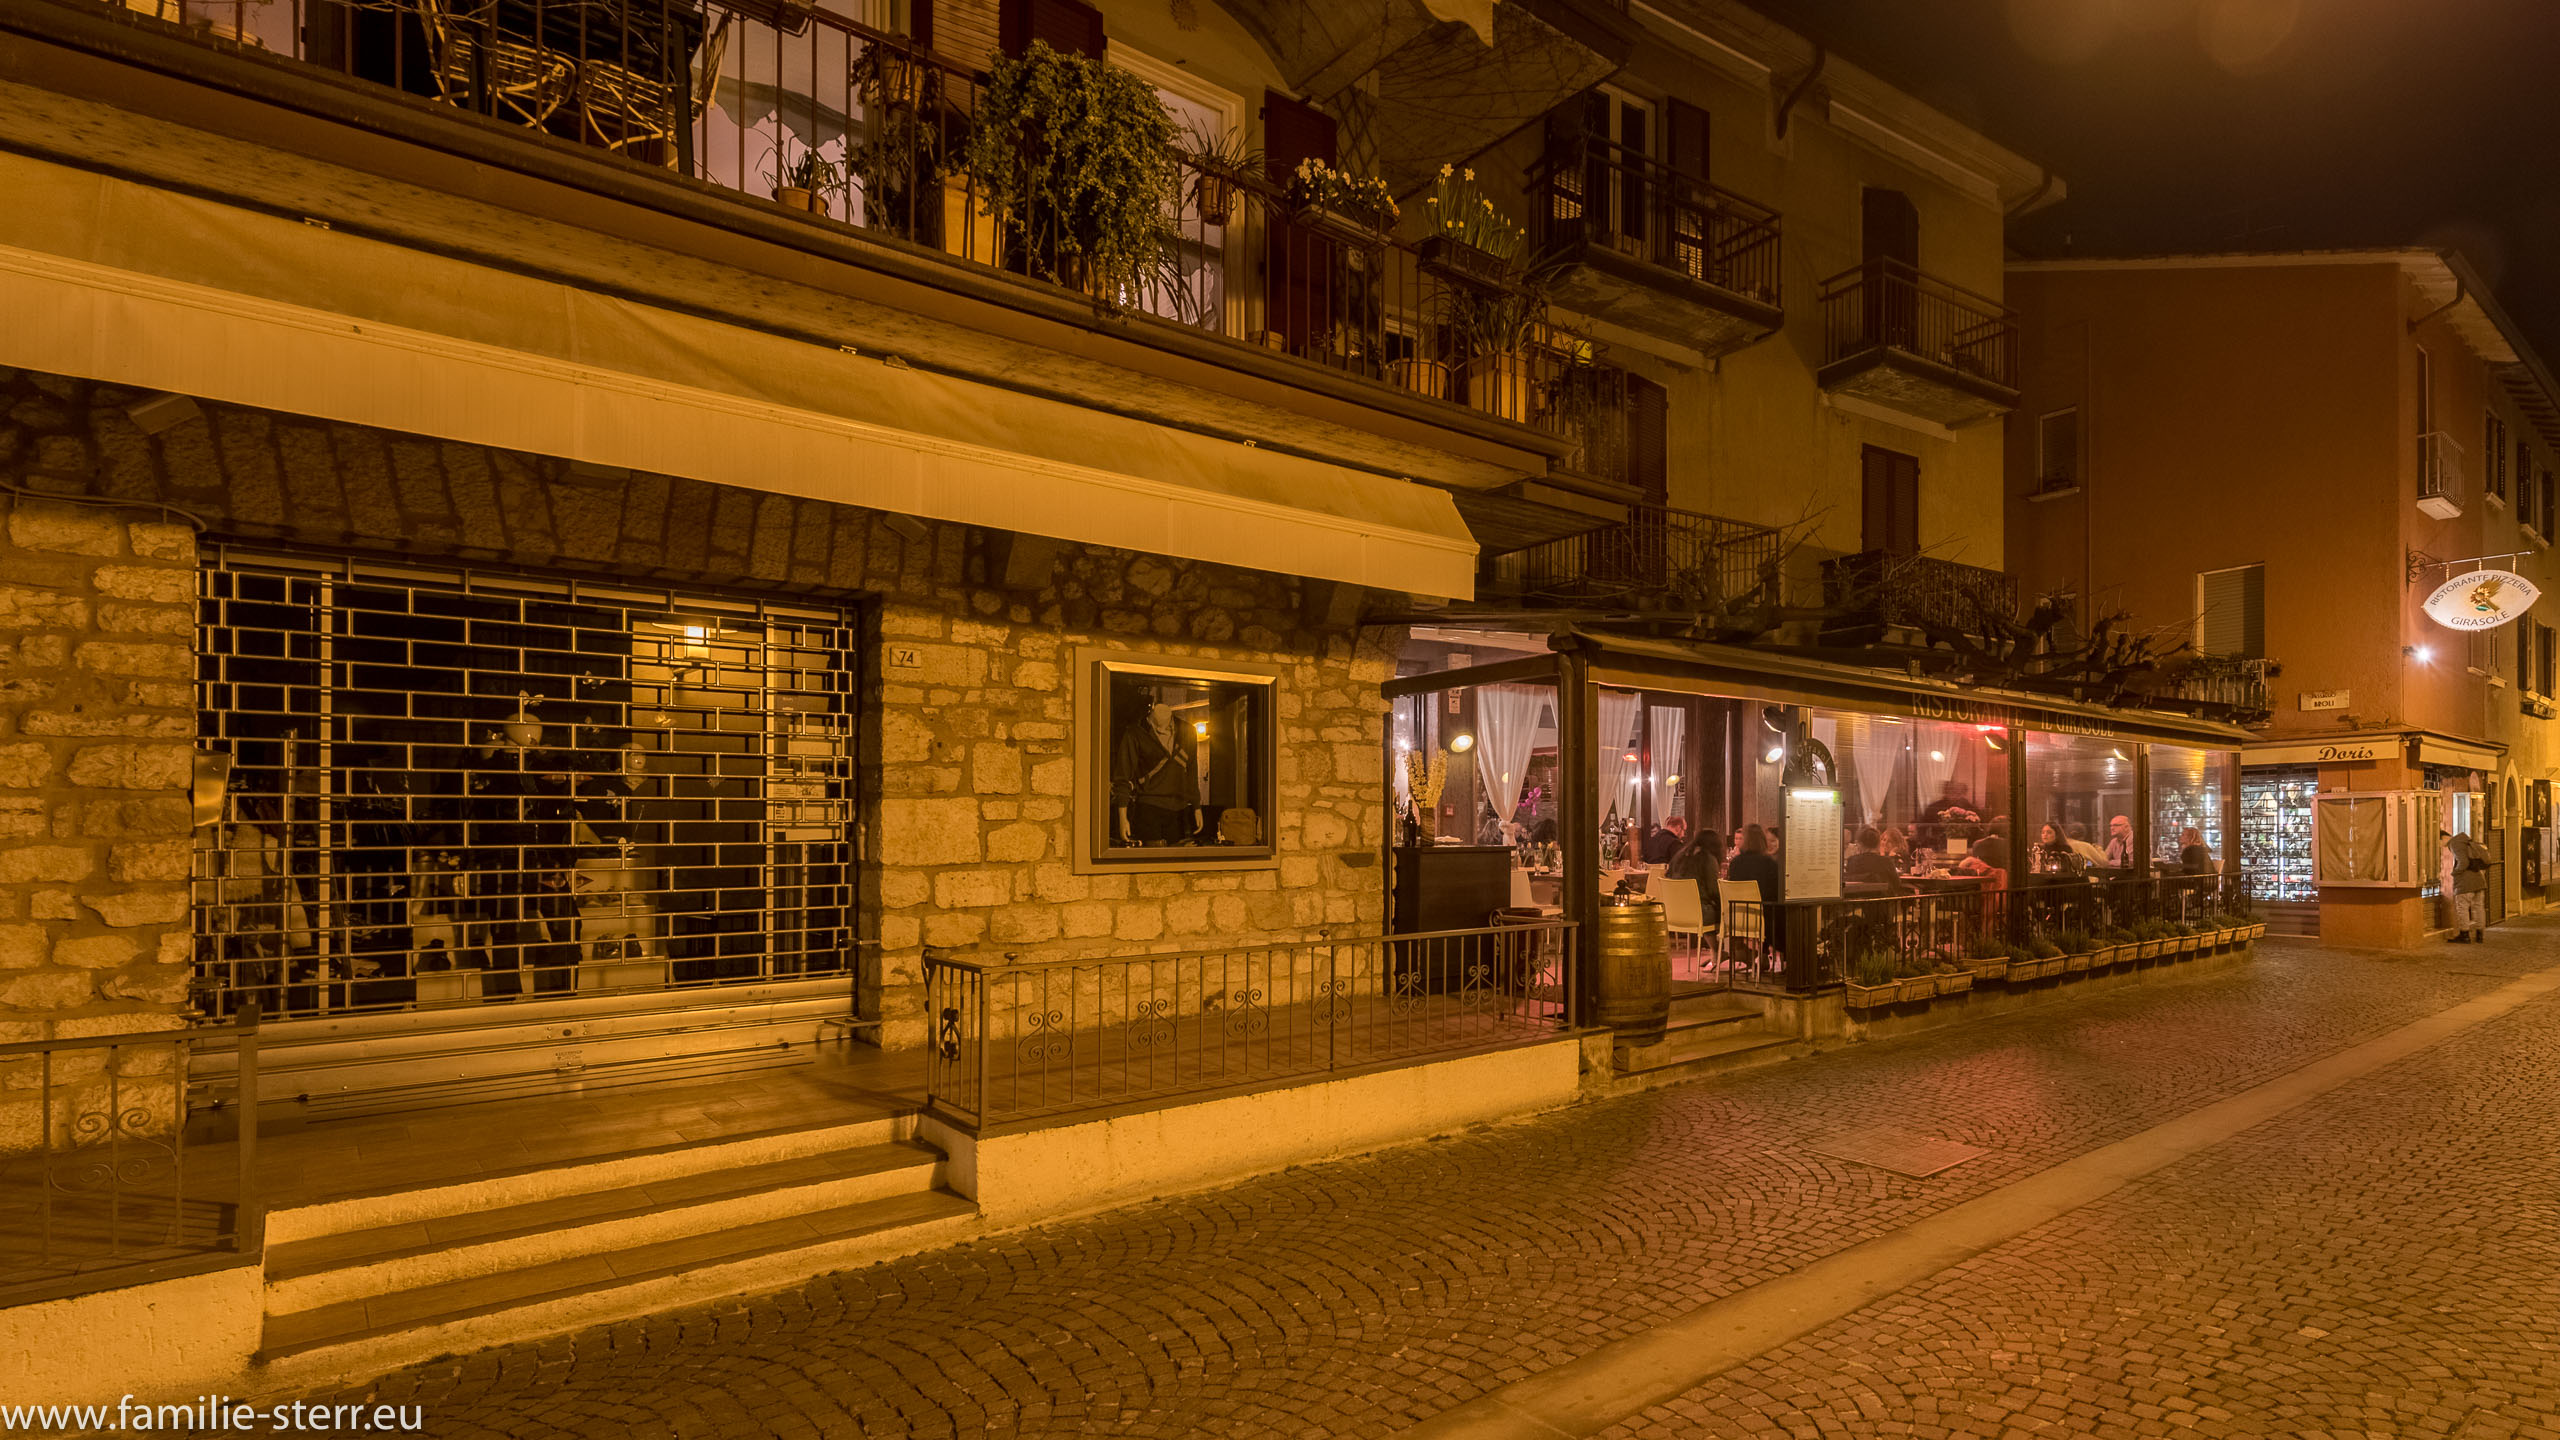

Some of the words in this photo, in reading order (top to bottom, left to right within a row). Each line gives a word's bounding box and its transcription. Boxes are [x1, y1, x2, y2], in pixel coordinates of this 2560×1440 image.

[2430, 574, 2489, 606] RISTORANTE
[2491, 574, 2532, 597] PIZZERIA
[2450, 610, 2510, 626] GIRASOLE
[899, 650, 914, 665] 74
[2314, 700, 2335, 708] BROLI
[1912, 693, 2025, 727] RISTORANTE
[2041, 711, 2053, 730] IL
[2056, 712, 2114, 737] GIRASOLE
[2318, 746, 2374, 761] Doris
